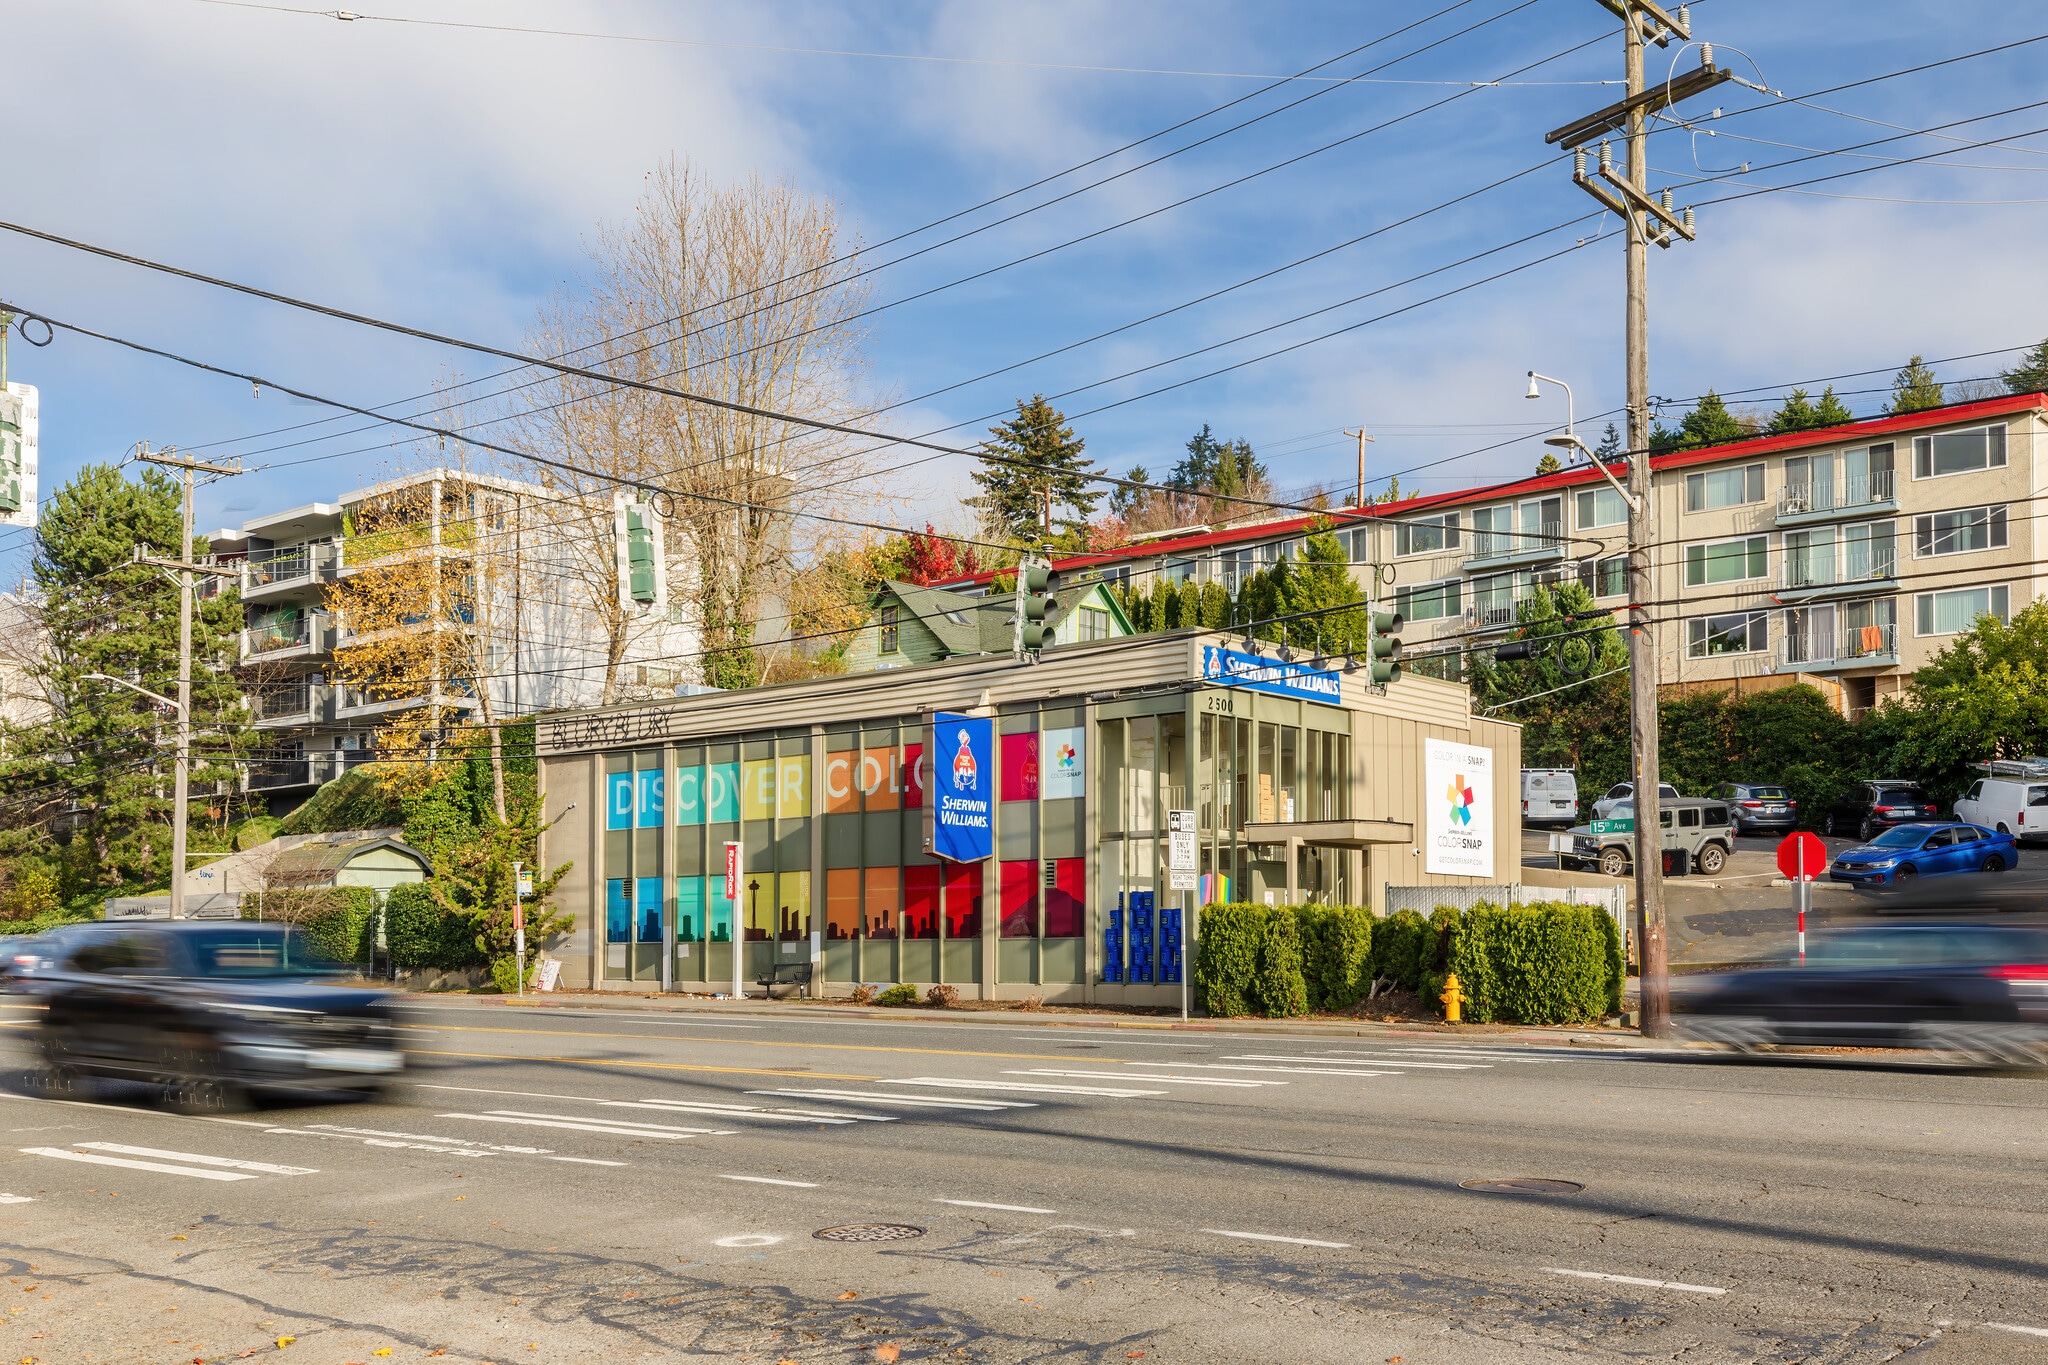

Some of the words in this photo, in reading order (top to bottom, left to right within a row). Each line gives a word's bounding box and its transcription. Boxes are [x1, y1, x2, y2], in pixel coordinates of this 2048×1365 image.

[1208, 696, 1234, 713] 2500
[615, 764, 805, 815] DISCOVER
[941, 795, 987, 813] SHERWIN
[1181, 814, 1193, 822] CURB
[1592, 821, 1611, 833] 15th
[1613, 822, 1626, 830] Ave
[1176, 841, 1190, 849] ONLY
[1437, 836, 1483, 850] COLORSNAP
